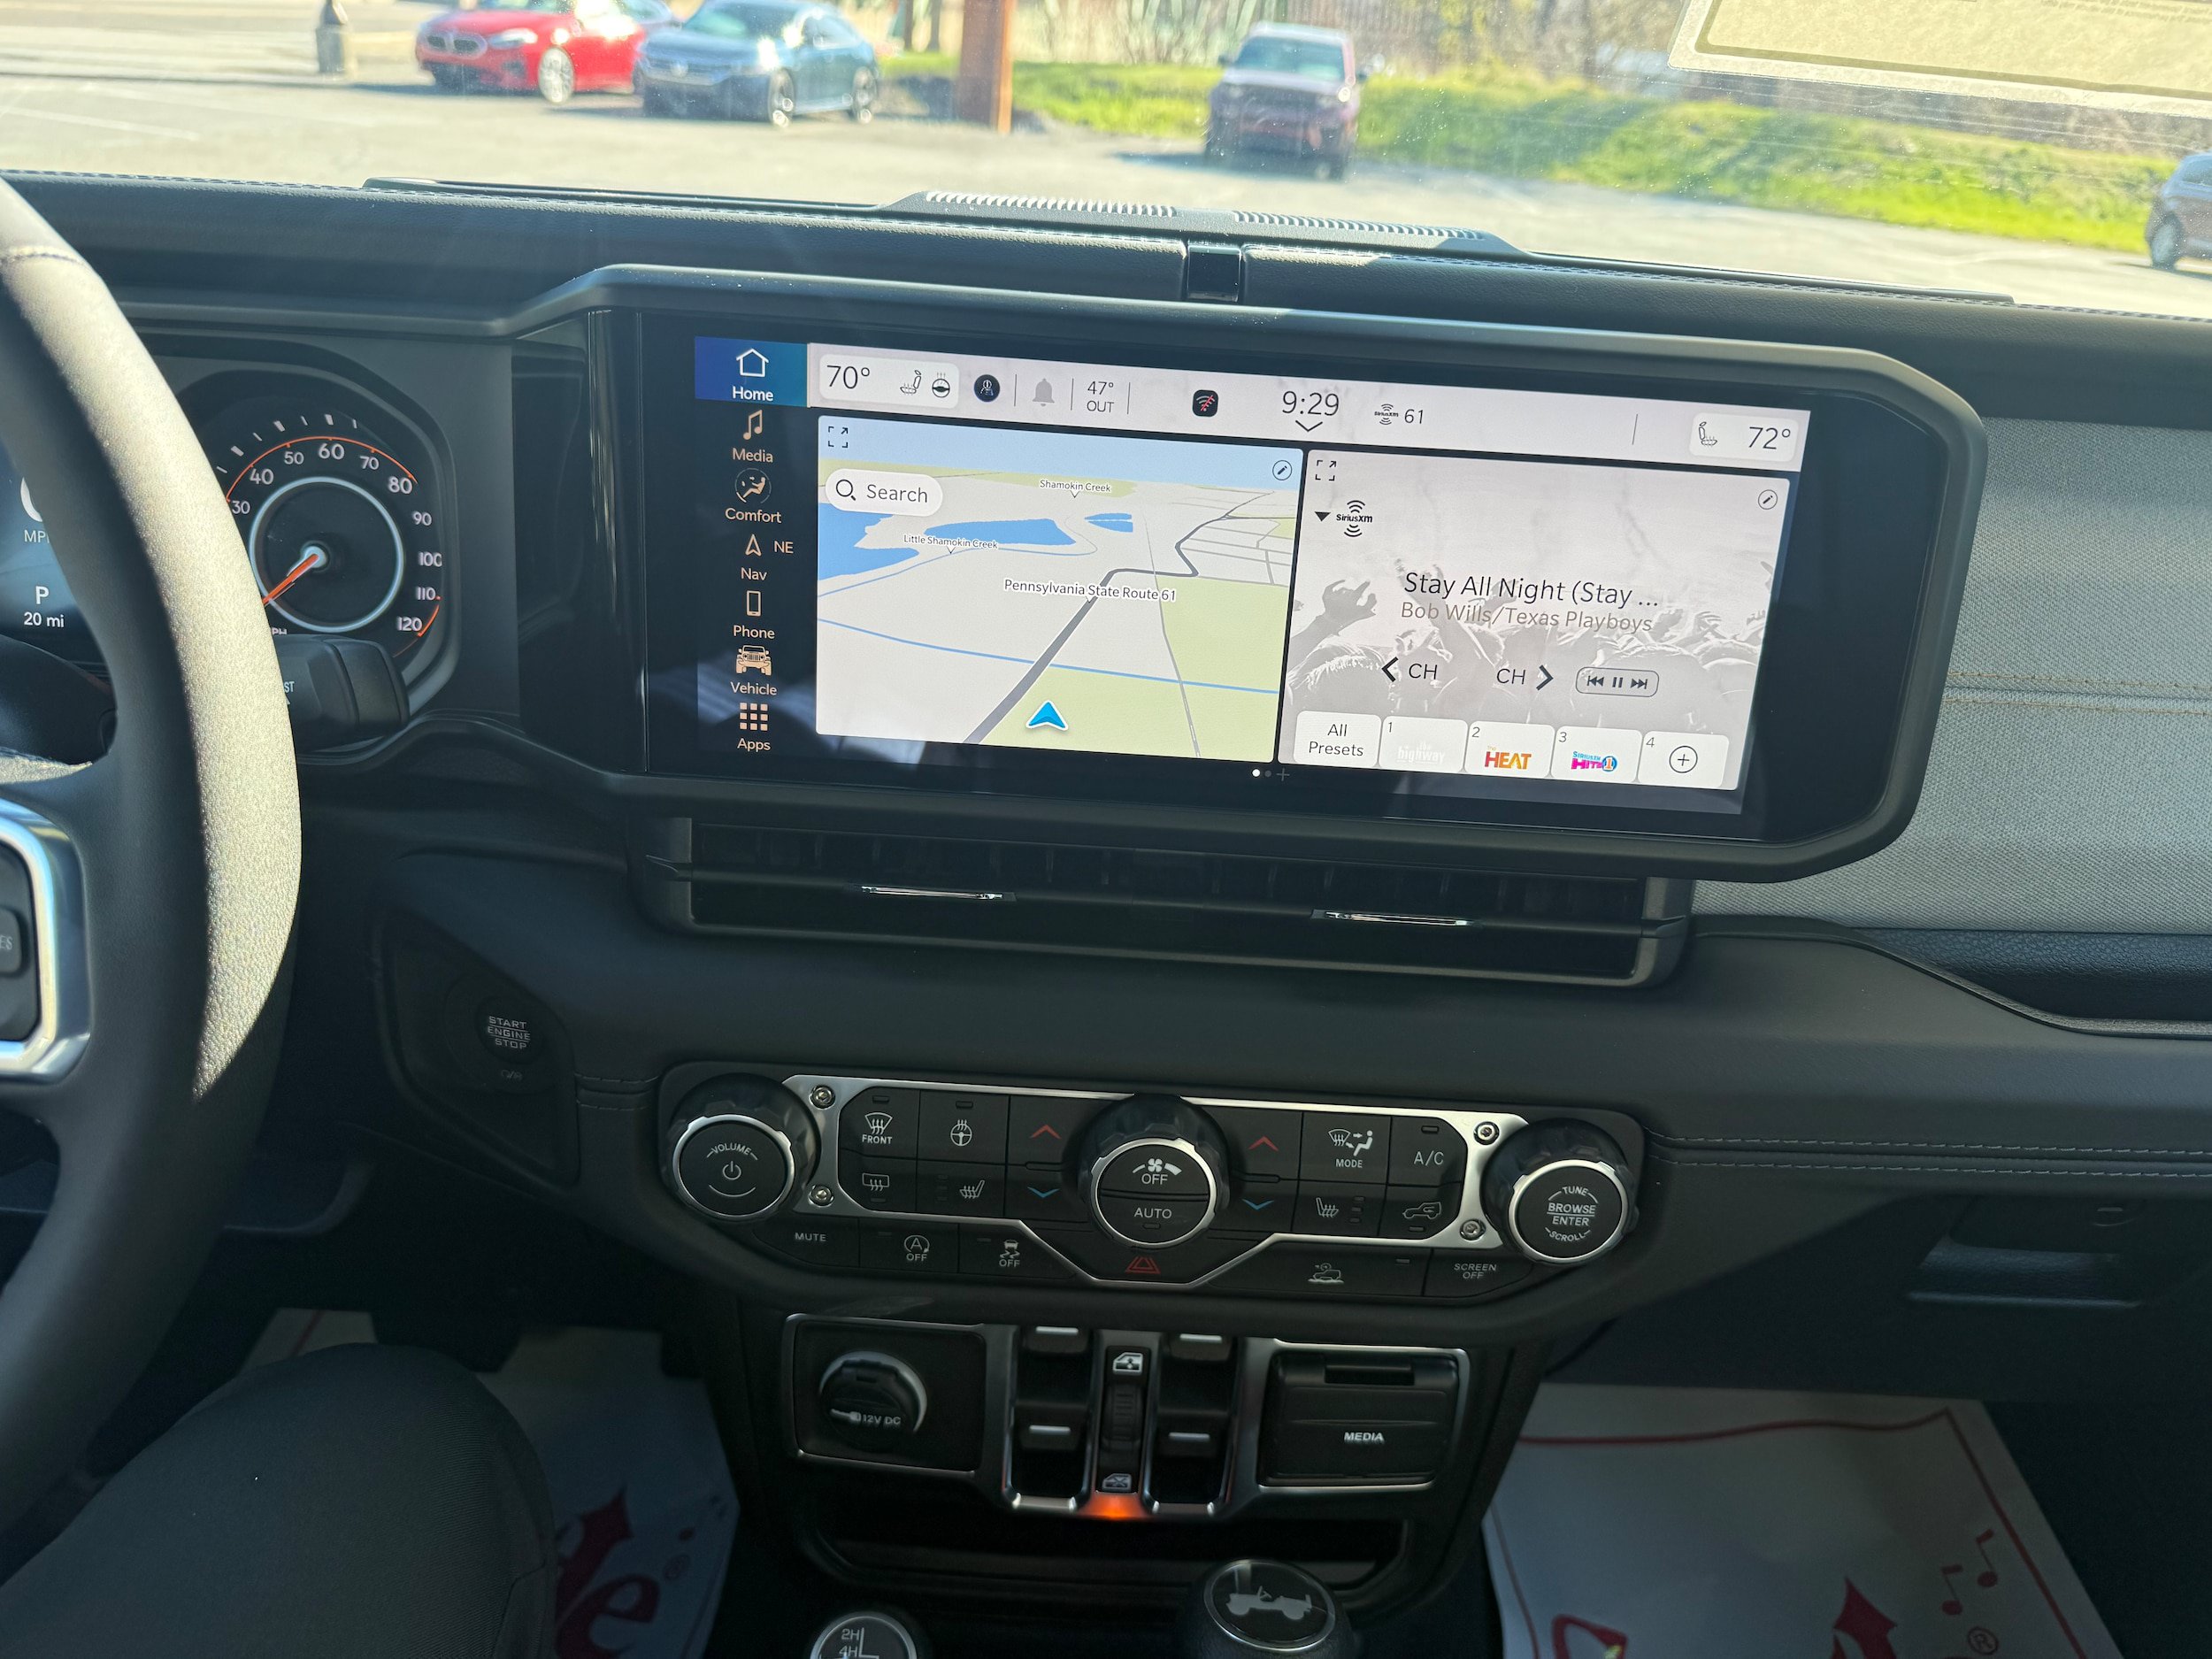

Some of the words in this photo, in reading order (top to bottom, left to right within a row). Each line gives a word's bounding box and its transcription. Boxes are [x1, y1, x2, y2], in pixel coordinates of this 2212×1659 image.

[826, 365, 871, 389] 70°
[733, 386, 773, 401] Home
[1087, 380, 1114, 396] 47°
[1087, 400, 1114, 414] OUT
[1282, 390, 1340, 416] 9:29
[1404, 409, 1423, 424] 61
[1747, 426, 1792, 449] 72°
[283, 451, 304, 465] 50
[318, 443, 345, 459] 60
[733, 448, 773, 463] Media
[359, 456, 380, 471] 70
[250, 468, 274, 485] 40
[388, 476, 412, 495] 80
[1040, 480, 1083, 491] Shamokin
[1085, 481, 1111, 493] Creek
[866, 484, 928, 503] Search
[232, 500, 250, 514] 30
[413, 511, 432, 526] 90
[725, 507, 782, 524] Comfort
[774, 541, 794, 554] NE
[903, 534, 925, 545] Little
[926, 536, 972, 548] Shamokin
[973, 539, 998, 549] Creek
[419, 552, 442, 567] 100
[741, 567, 767, 580] Nav
[35, 586, 50, 604] P
[417, 587, 436, 601] 110
[1004, 579, 1085, 595] Pennsylvania
[1088, 585, 1120, 597] State
[1123, 588, 1158, 600] Route
[1162, 589, 1176, 602] 61
[1404, 572, 1455, 599] Stay
[1461, 575, 1492, 596] All
[1499, 577, 1566, 604] Night
[1572, 580, 1632, 610] (Stay
[24, 612, 42, 626] 20
[47, 615, 65, 628] mi
[398, 617, 422, 632] 120
[1402, 602, 1440, 619] Bob
[1446, 603, 1559, 626] Wills/Texas
[1565, 611, 1652, 634] Playboys
[733, 625, 775, 640] Phone
[1409, 663, 1438, 680] CH
[1496, 667, 1525, 685] CH
[284, 680, 295, 693] ST
[730, 681, 777, 695] Vehicle
[1327, 723, 1348, 737] All
[1387, 722, 1393, 733] 1
[1471, 727, 1480, 738] 2
[1558, 732, 1567, 743] 3
[1646, 737, 1655, 748] 4
[737, 738, 771, 752] Apps
[1309, 741, 1363, 757] Presets
[1485, 751, 1532, 770] HEAT
[0, 935, 12, 950] ES
[488, 1016, 527, 1029] START
[488, 1025, 531, 1041] ENGINE
[495, 1038, 527, 1049] STOP
[862, 1133, 893, 1145] FRONT
[710, 1142, 752, 1156] VOLUME
[1335, 1159, 1363, 1169] MODE
[1414, 1150, 1444, 1166] A/C
[1141, 1173, 1168, 1185] OFF
[1562, 1186, 1589, 1196] TUNE
[1133, 1208, 1172, 1219] AUTO
[1548, 1202, 1596, 1214] BROWSE
[1552, 1216, 1590, 1226] ENTER
[795, 1233, 826, 1242] MUTE
[1549, 1230, 1586, 1242] SCROLL
[906, 1253, 928, 1262] OFF
[999, 1259, 1021, 1268] OFF
[1454, 1263, 1497, 1272] SCREEN
[862, 1414, 882, 1425] 12V
[884, 1416, 902, 1425] DC
[1344, 1432, 1385, 1443] MEDIA
[841, 1628, 860, 1640] 2H
[839, 1645, 858, 1657] 4H
